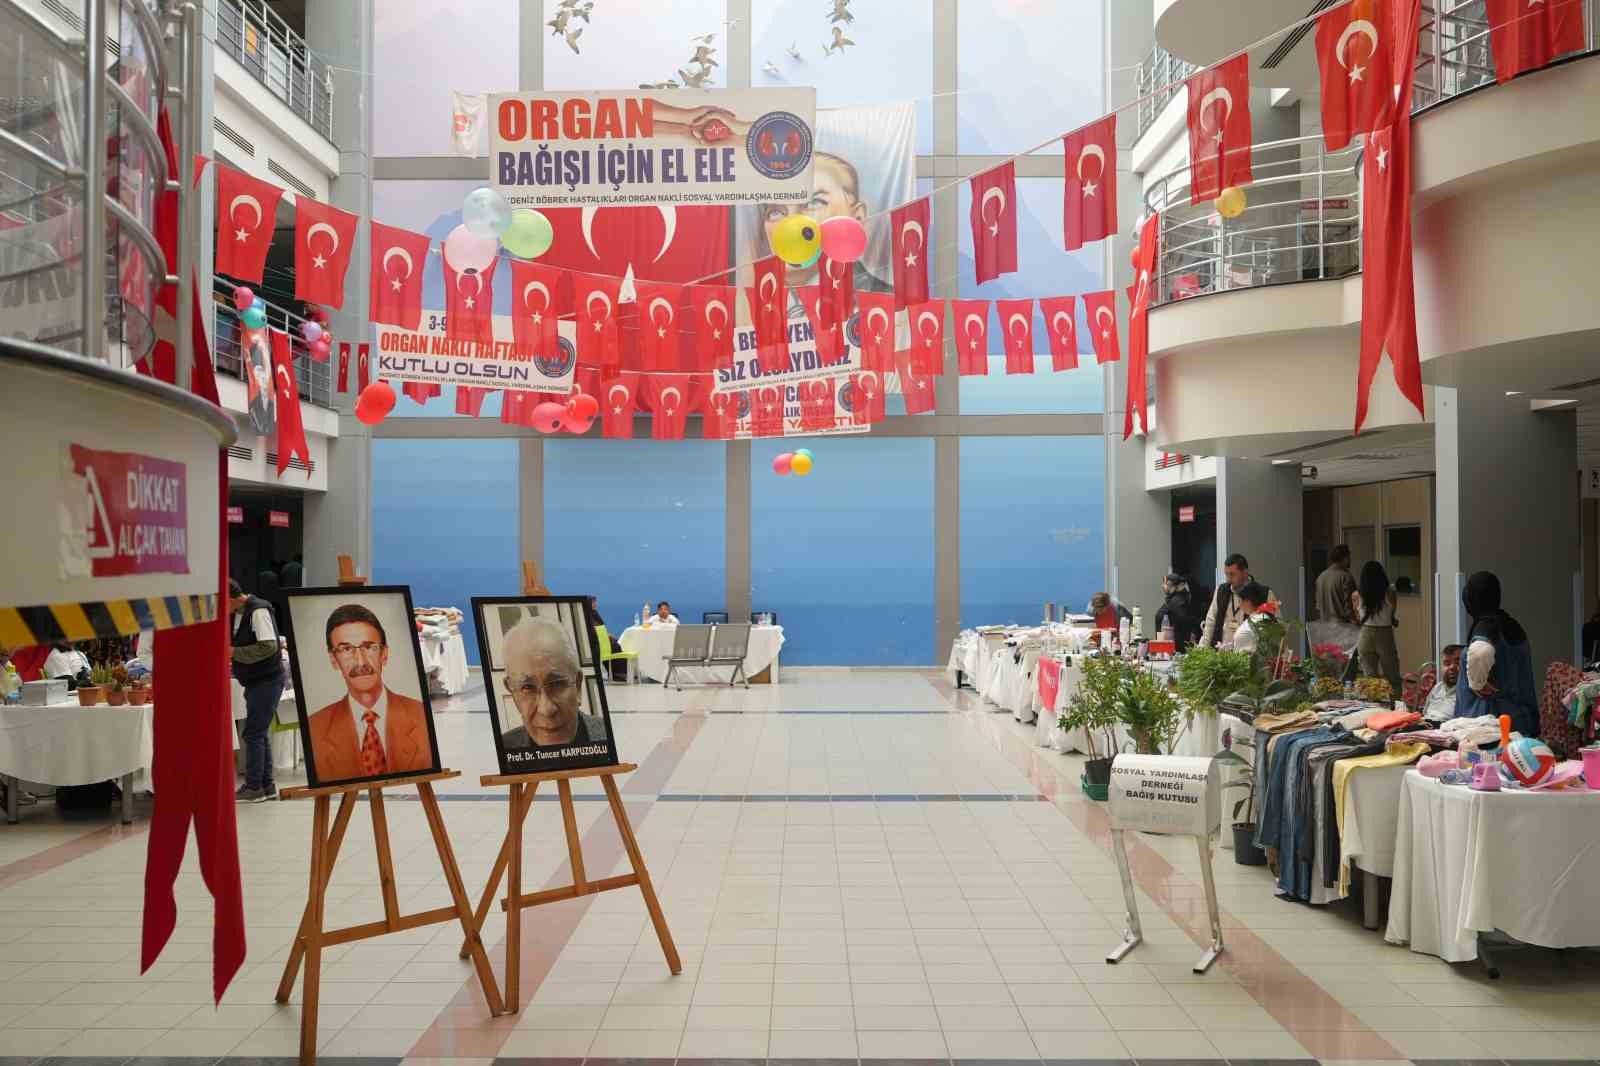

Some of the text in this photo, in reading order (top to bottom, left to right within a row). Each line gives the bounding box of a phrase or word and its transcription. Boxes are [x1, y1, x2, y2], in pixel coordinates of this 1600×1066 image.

[498, 97, 654, 141] ORGAN
[499, 144, 736, 192] BAĞIŞI İÇİN EL ELE
[506, 195, 533, 205] DENİZ
[628, 194, 657, 203] ORGAN
[683, 192, 713, 201] SOSYAL
[380, 332, 428, 354] ORGAN
[379, 356, 529, 381] KUTLU OLSUN
[127, 464, 179, 512] DİKKAT
[118, 524, 156, 563] ALÇAK
[506, 744, 608, 762] Prof. Dr. Tuncer KARPUZOĞLU
[1111, 767, 1146, 776] SOSYAL
[1141, 780, 1183, 790] DERNEĞİ
[1158, 793, 1198, 804] KUTUSU
